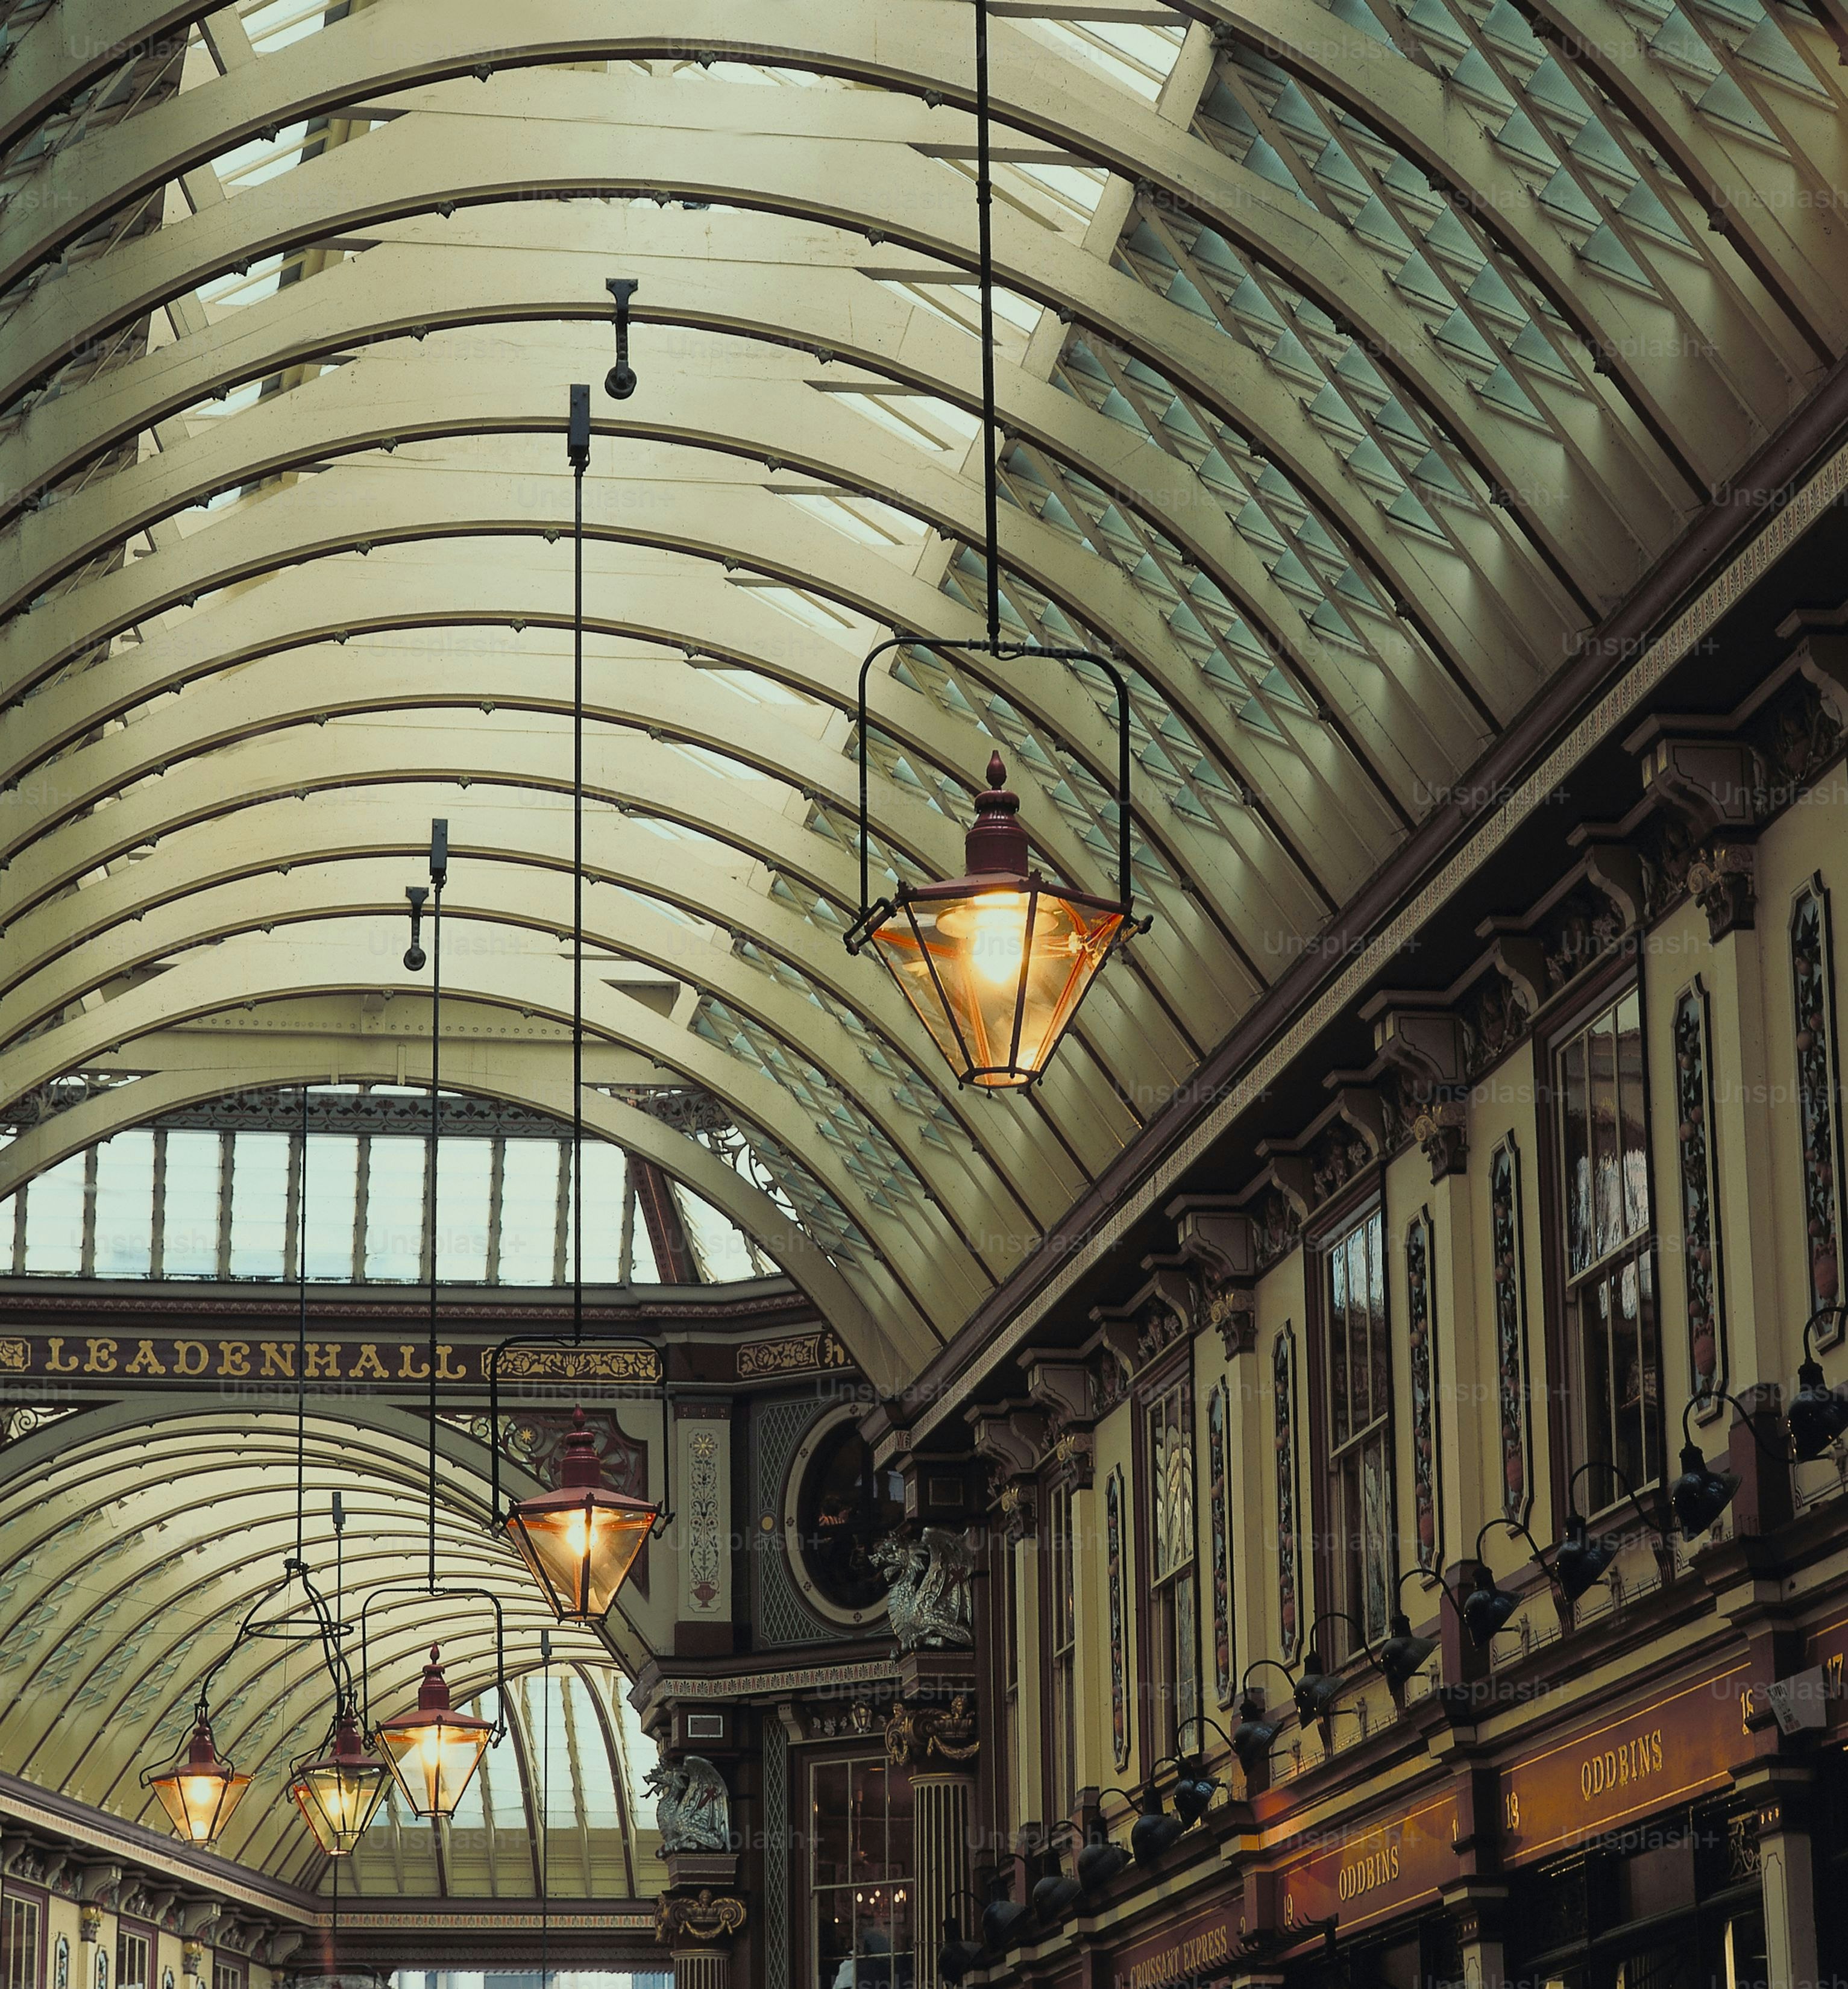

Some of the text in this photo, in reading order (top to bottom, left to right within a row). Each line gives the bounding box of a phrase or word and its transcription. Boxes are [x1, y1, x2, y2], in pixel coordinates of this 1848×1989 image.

[45, 1337, 467, 1379] LEADENHALL
[1827, 1653, 1843, 1699] 17
[1581, 1729, 1663, 1802] ODDBINS
[1506, 1791, 1520, 1830] 18
[1339, 1844, 1399, 1901] ODDBINS
[1284, 1893, 1293, 1926] 19
[1130, 1925, 1228, 1989] CROISSANT EXPRESS
